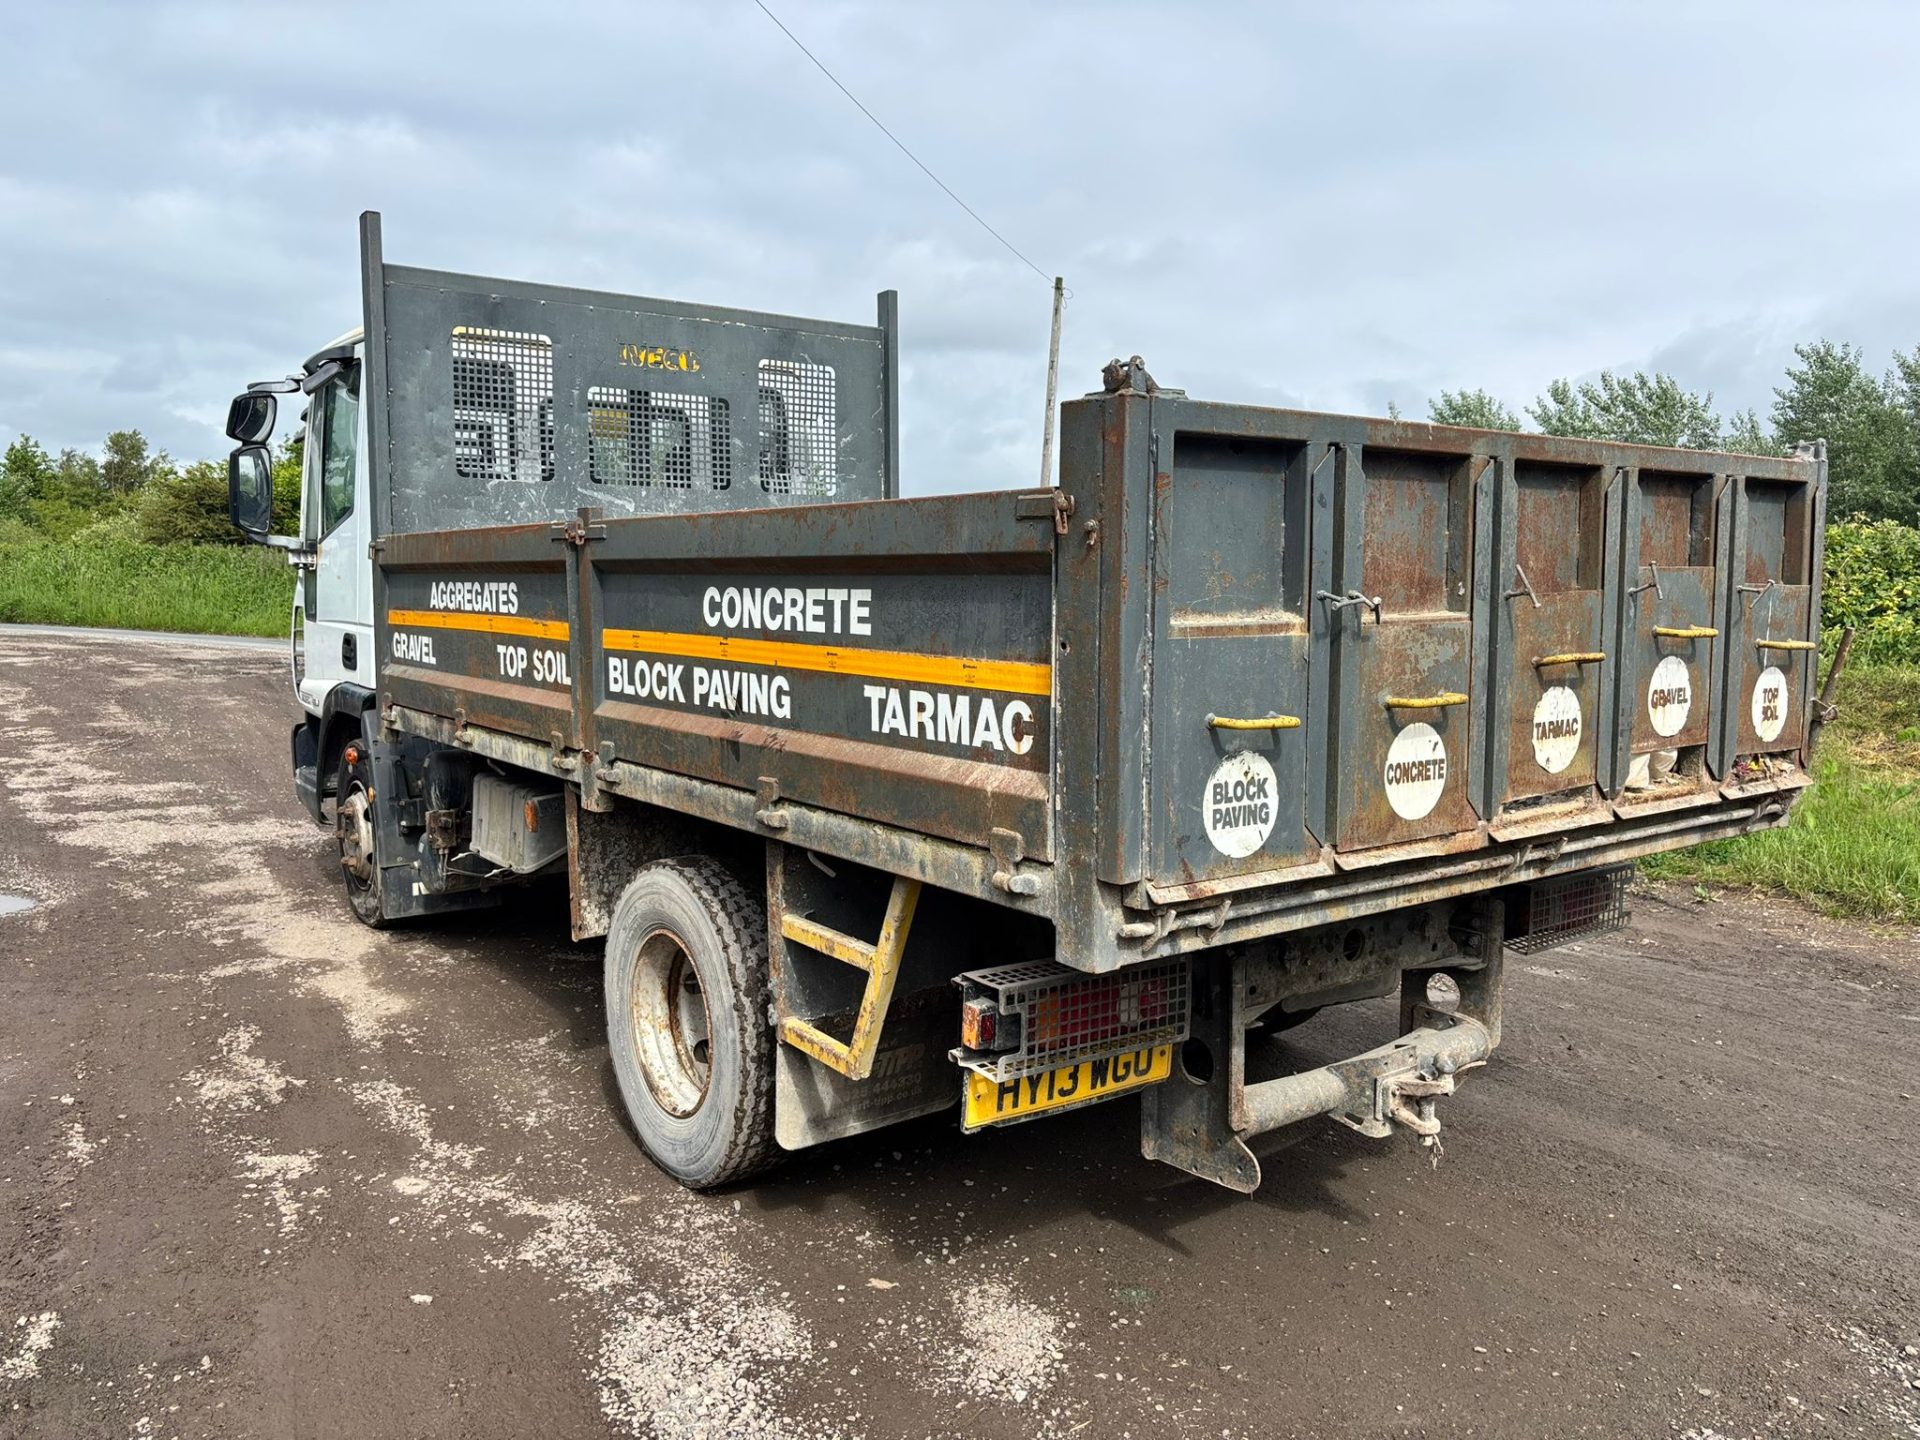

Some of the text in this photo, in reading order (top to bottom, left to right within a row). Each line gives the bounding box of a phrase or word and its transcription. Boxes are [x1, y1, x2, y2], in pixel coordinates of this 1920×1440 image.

[619, 342, 700, 373] IVECO
[430, 581, 518, 614] AGGREGATES
[703, 586, 872, 636] CONCRETE
[393, 632, 436, 665] GRAVEL
[497, 644, 571, 685] TOP SOIL
[608, 656, 791, 719] BLOCK PAVING
[1651, 687, 1688, 709] GRAVEL
[1763, 688, 1779, 704] TOP
[863, 684, 1034, 755] TARMAC
[1535, 717, 1579, 741] TARMAC
[1386, 758, 1446, 785] CONCRETE
[1213, 777, 1269, 805] BLOCK
[1213, 802, 1270, 831] PAVING
